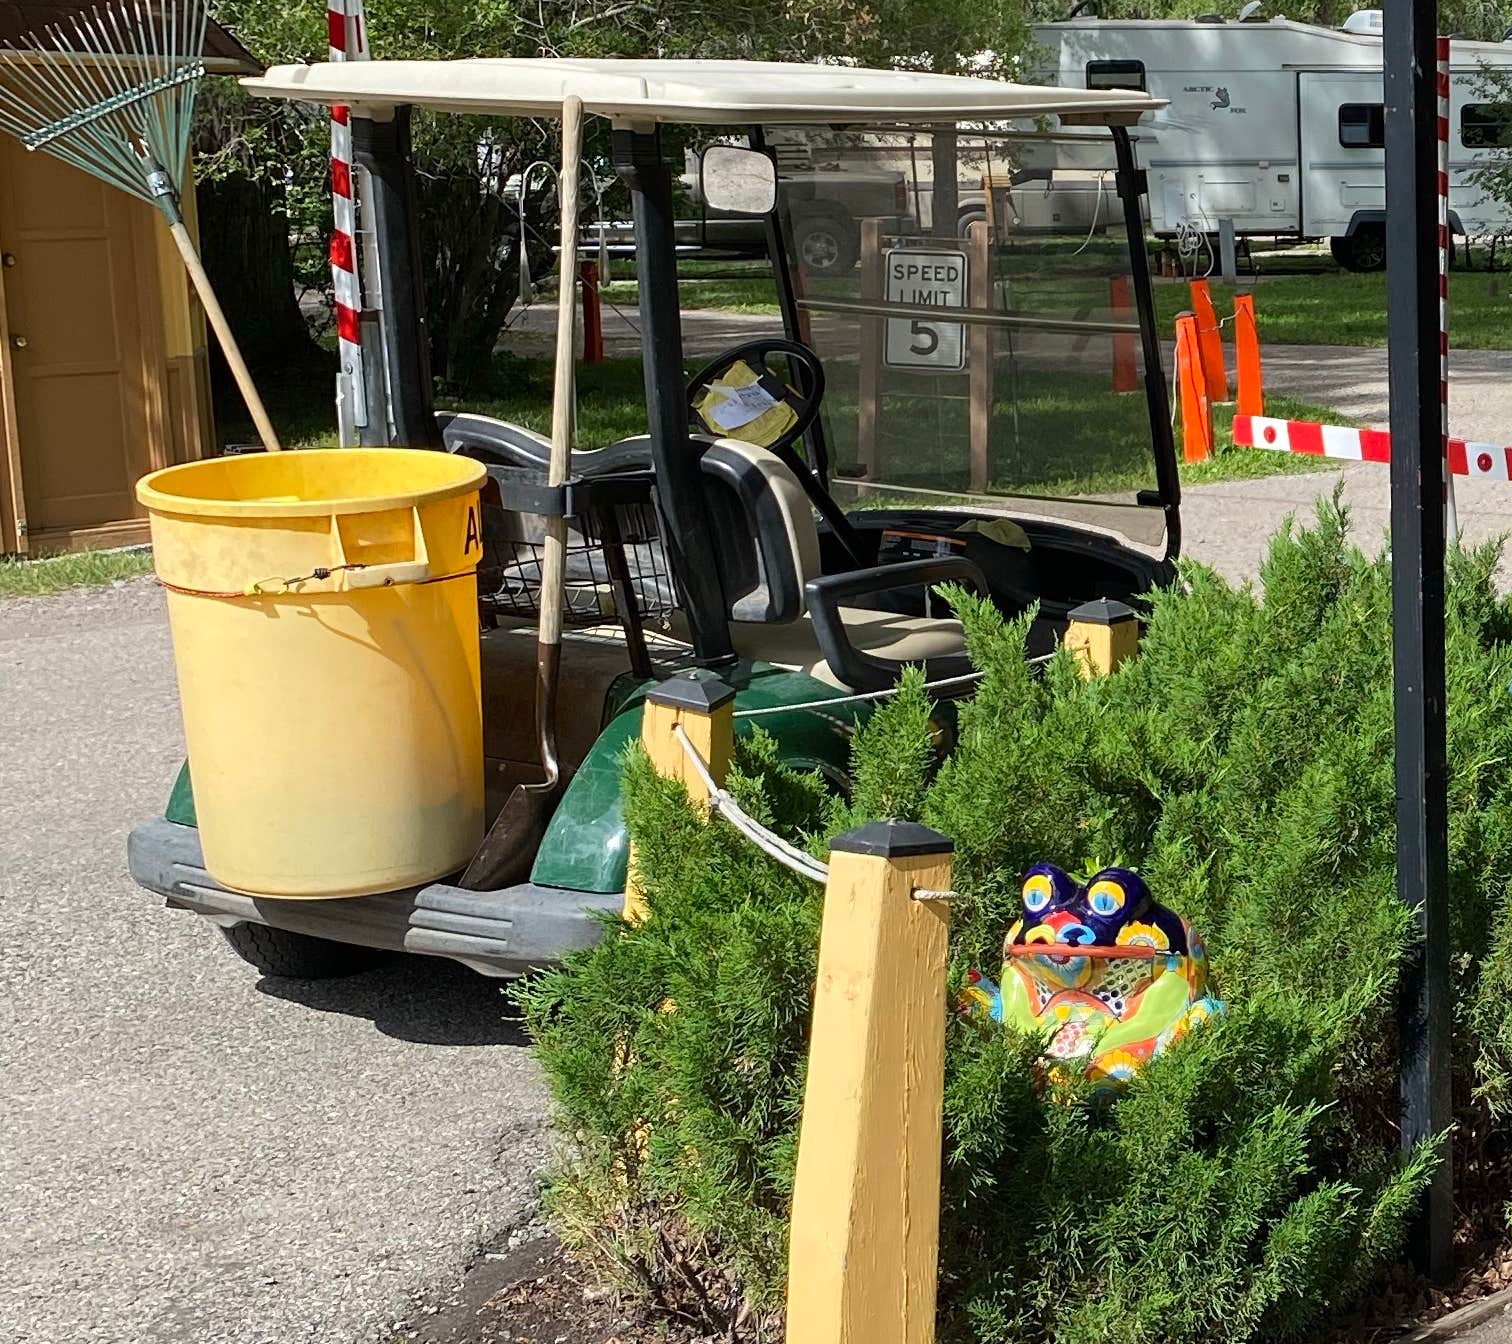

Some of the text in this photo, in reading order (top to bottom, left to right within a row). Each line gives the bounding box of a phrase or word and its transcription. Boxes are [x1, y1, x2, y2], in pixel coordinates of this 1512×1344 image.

[893, 264, 959, 282] SPEED
[900, 289, 951, 306] LIMIT
[909, 320, 939, 356] 5
